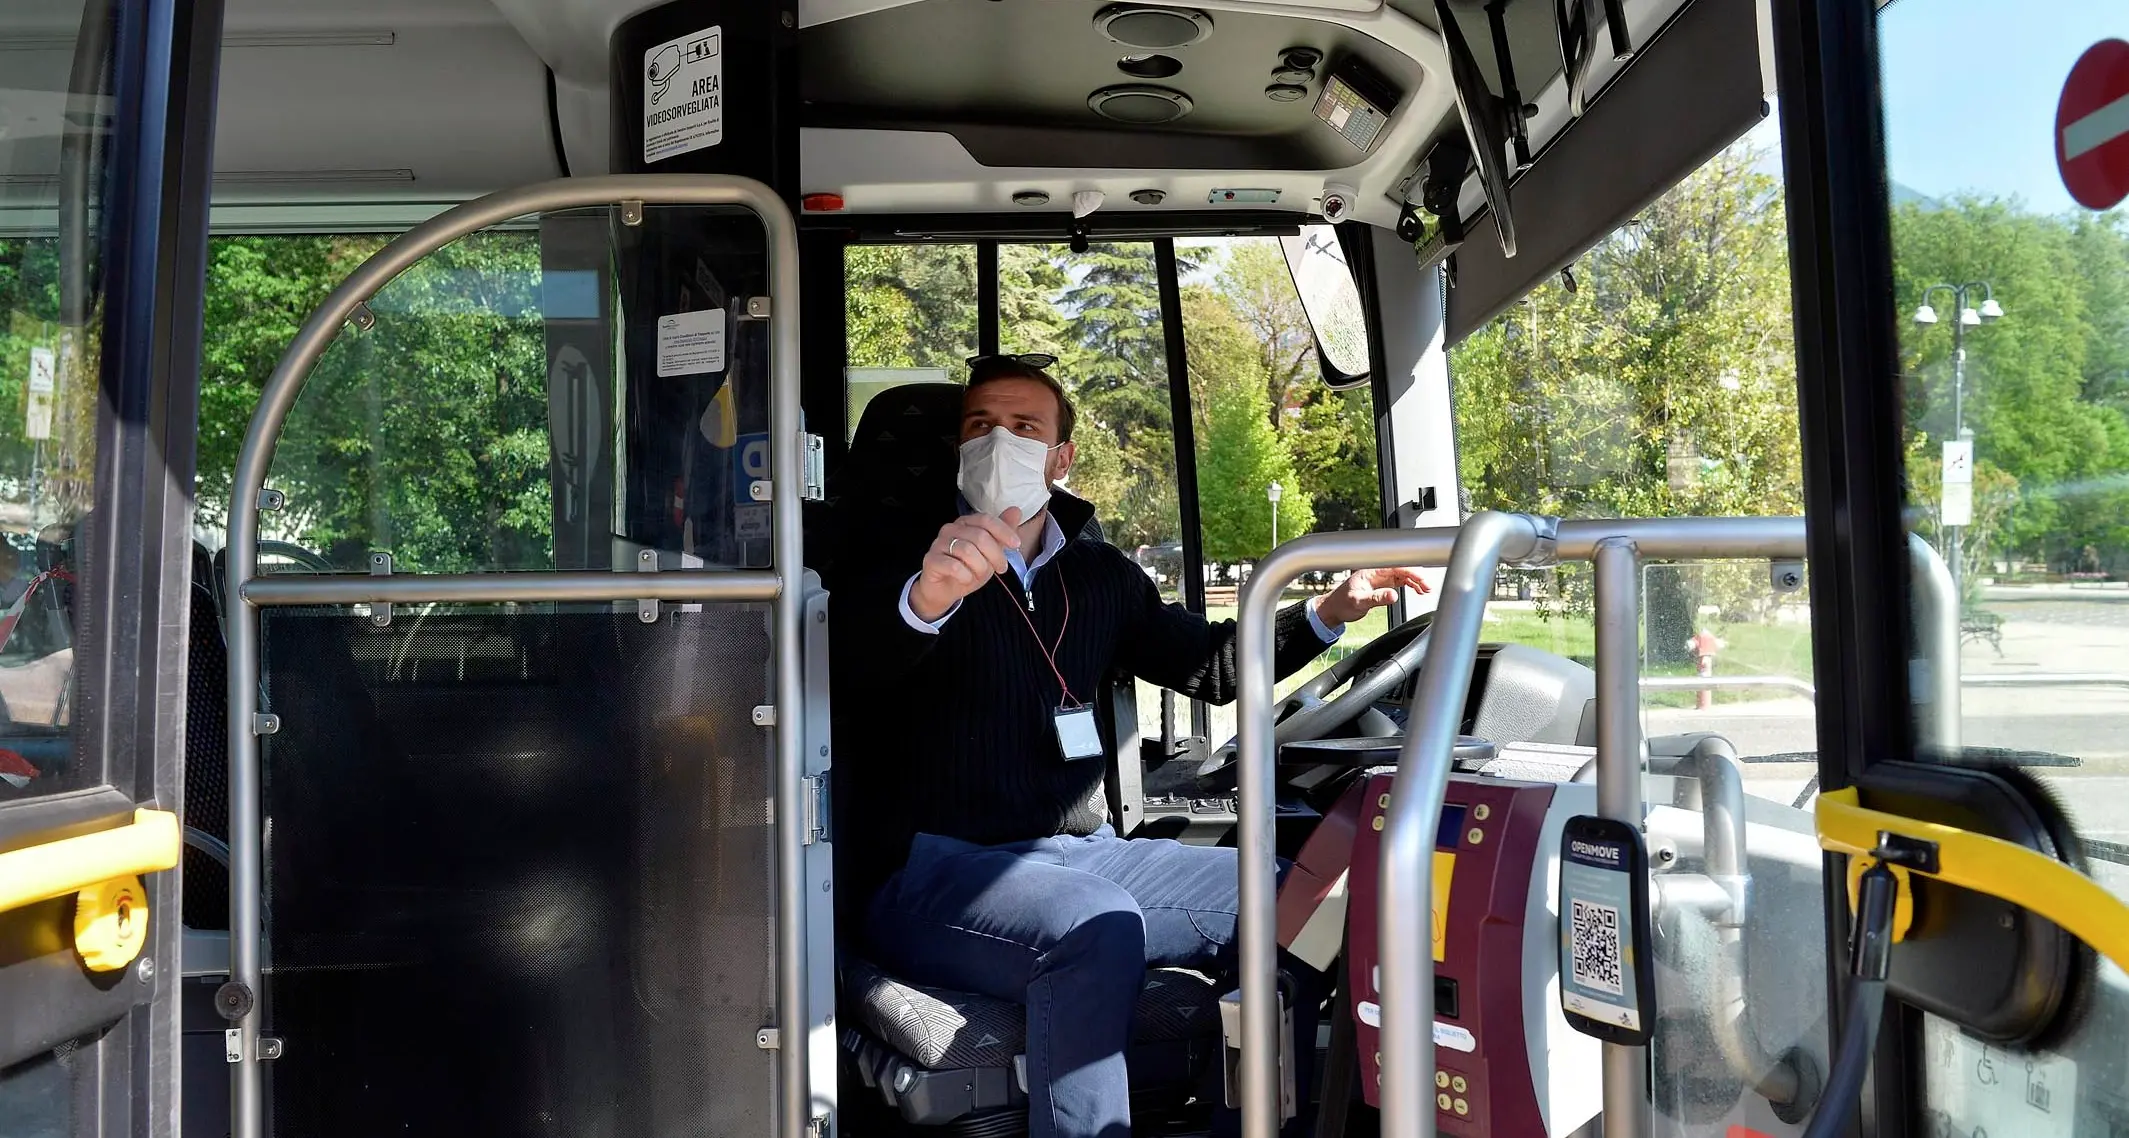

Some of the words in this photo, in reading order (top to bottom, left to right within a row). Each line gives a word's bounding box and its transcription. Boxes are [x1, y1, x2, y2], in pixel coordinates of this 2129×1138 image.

[692, 75, 719, 97] AREA
[646, 95, 719, 128] VIDEOSORVEGLIATA
[1571, 840, 1619, 859] OPENMOVE
